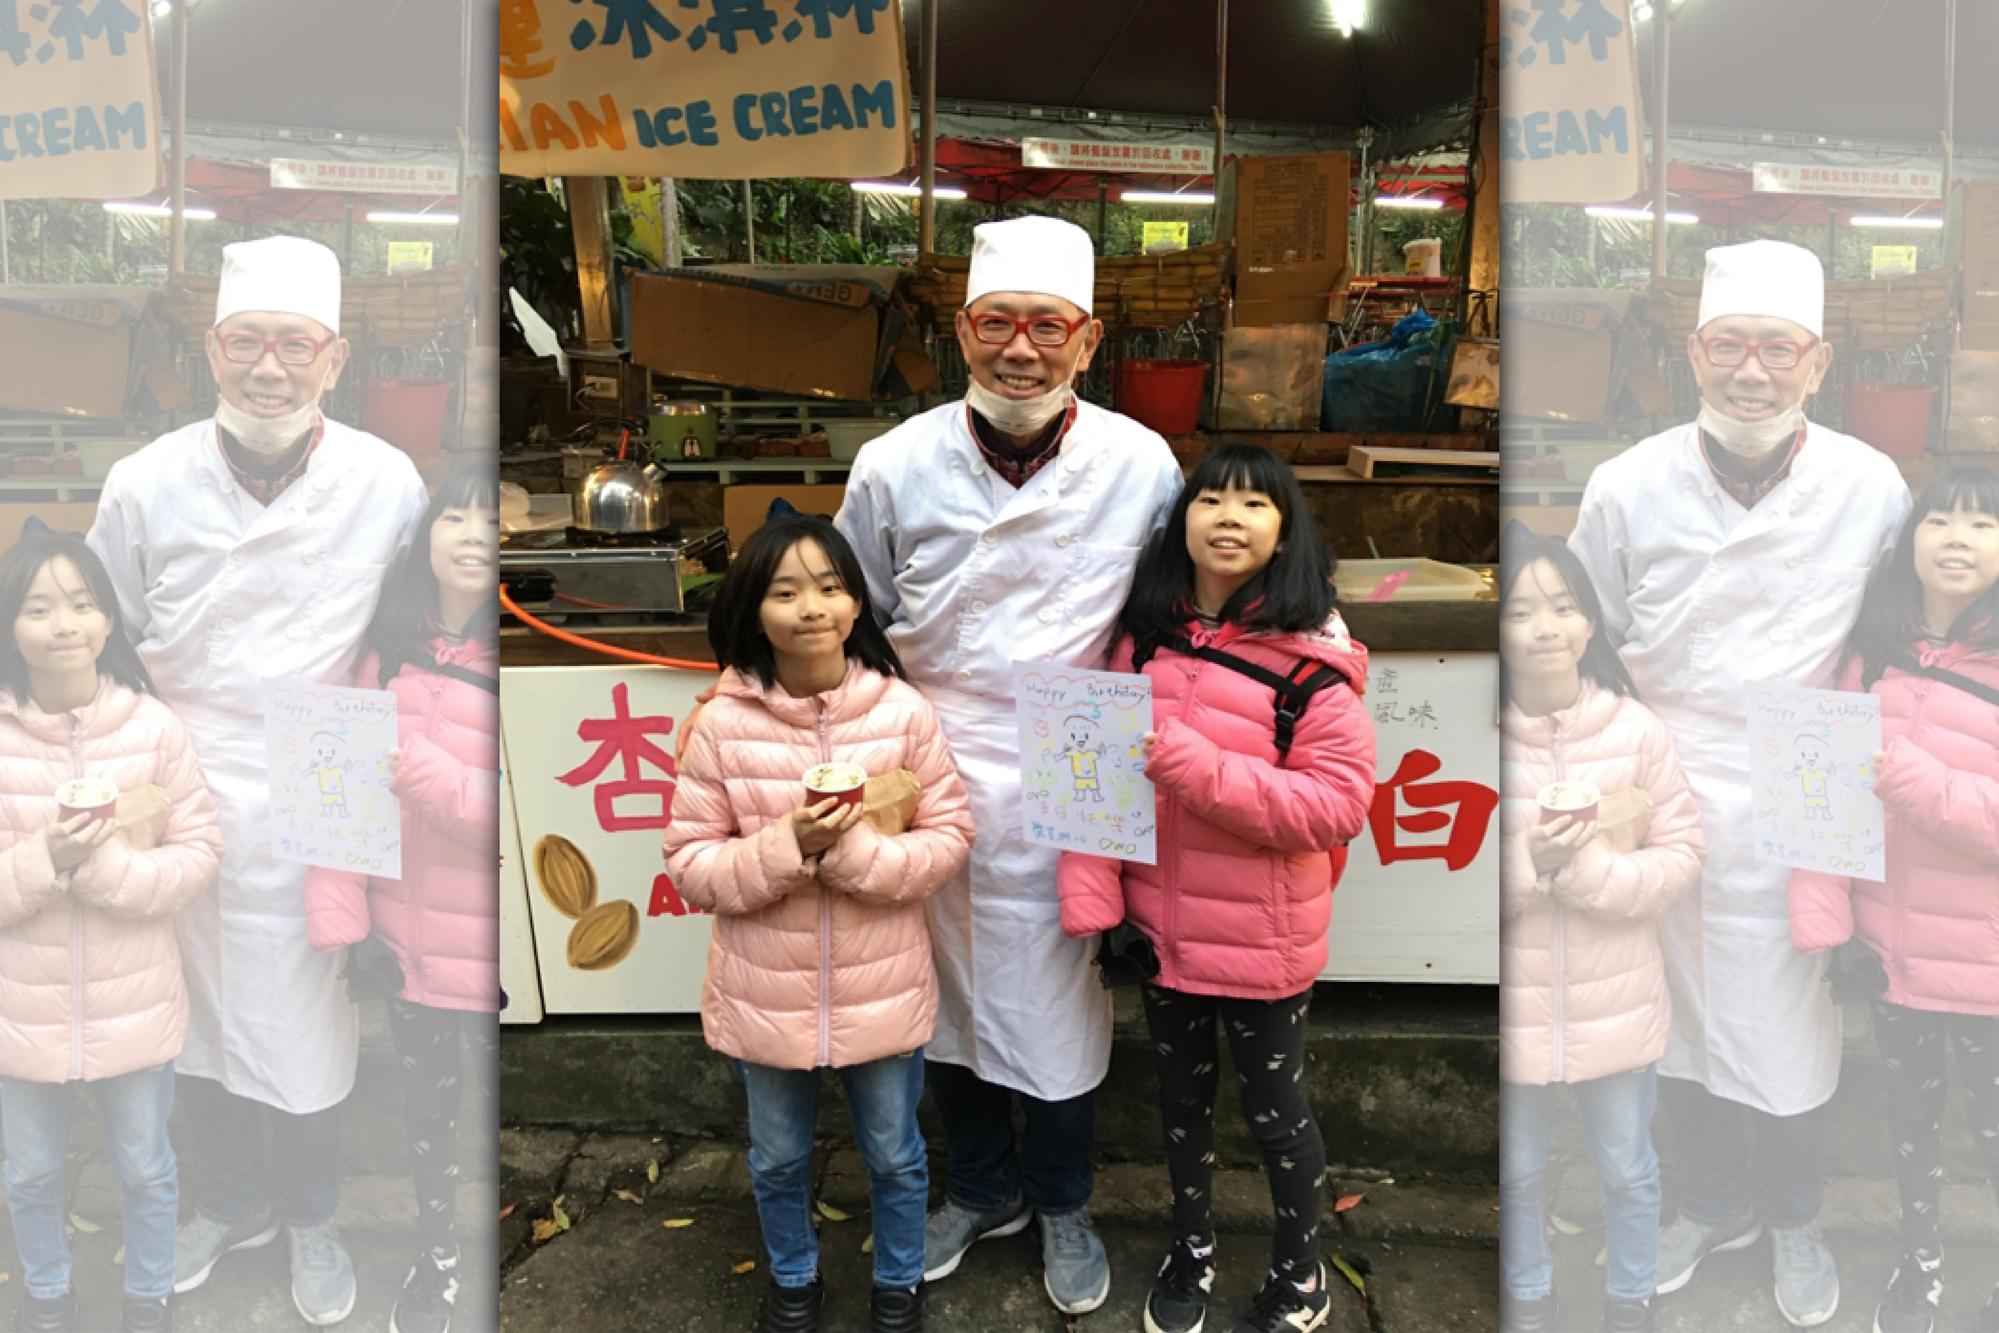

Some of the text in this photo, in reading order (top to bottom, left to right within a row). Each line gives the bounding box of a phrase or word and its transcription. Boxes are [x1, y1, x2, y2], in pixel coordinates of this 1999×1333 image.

[632, 101, 719, 148] ICE
[733, 80, 896, 141] CREAM
[1026, 683, 1066, 701] Happy
[554, 681, 678, 832] 杏
[1369, 748, 1499, 872] 白
[647, 872, 715, 917] A
